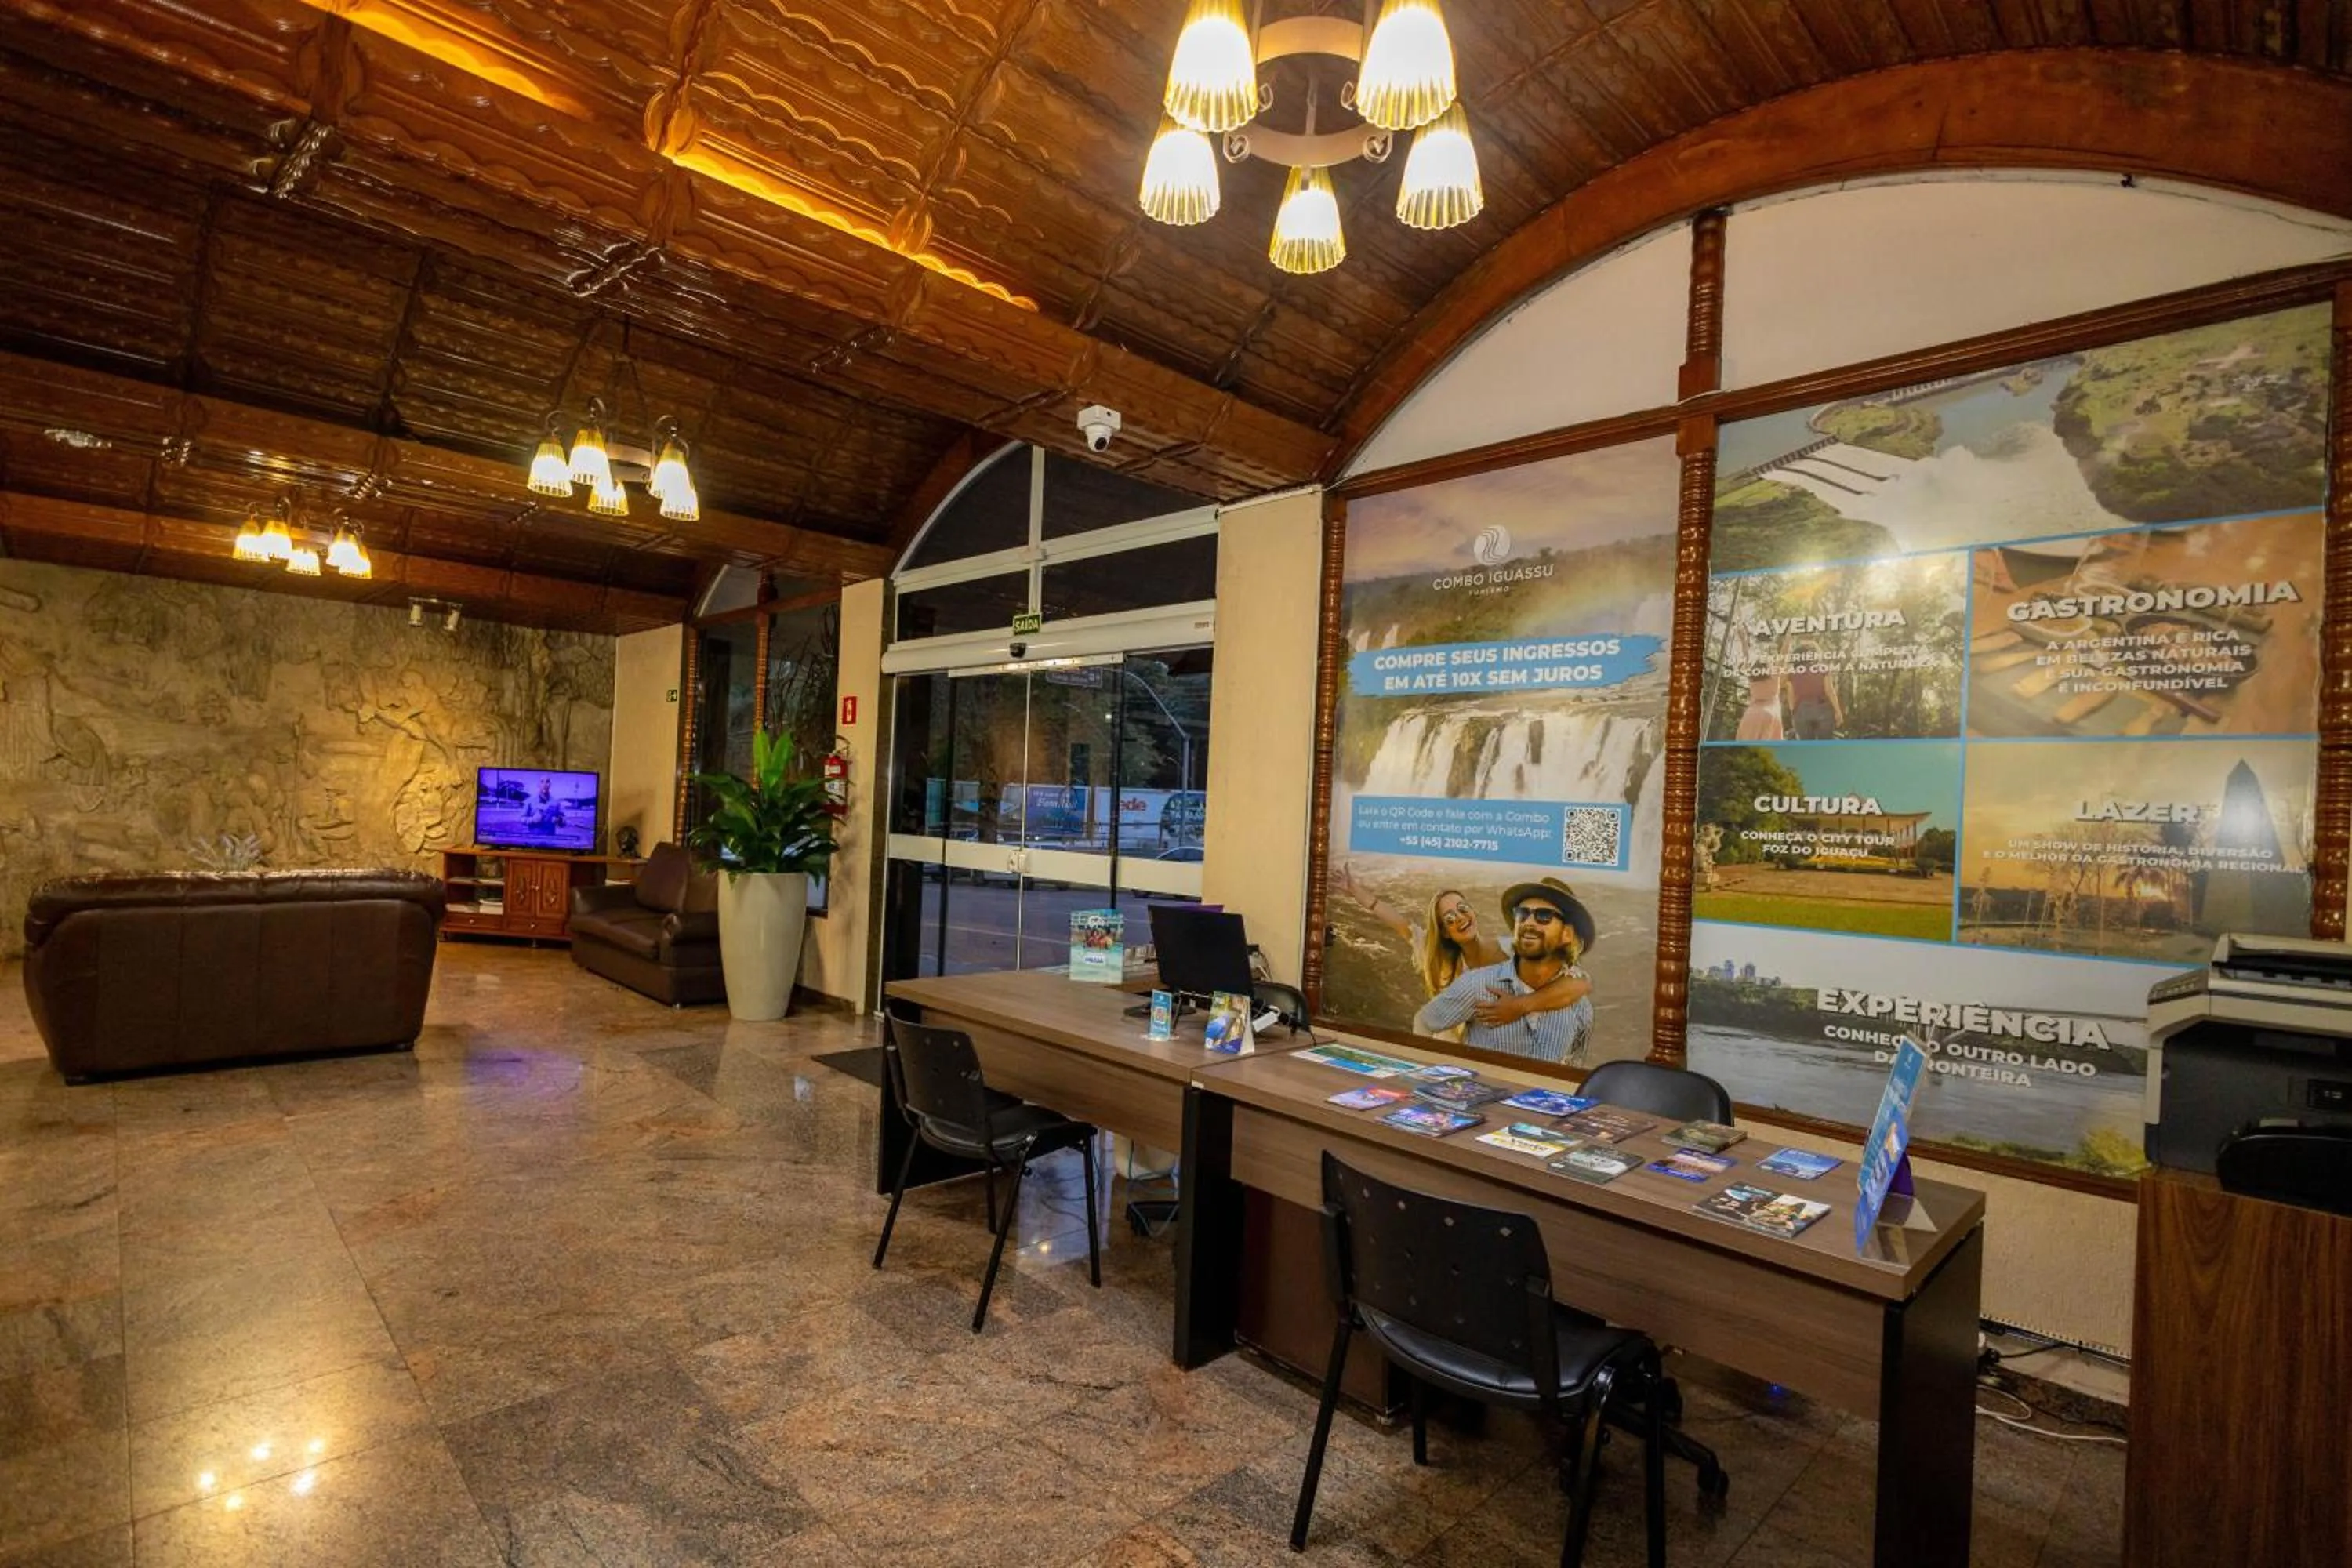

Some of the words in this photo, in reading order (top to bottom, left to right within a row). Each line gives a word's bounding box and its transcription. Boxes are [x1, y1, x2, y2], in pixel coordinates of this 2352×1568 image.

[1432, 573, 1484, 590] COMBO
[1490, 564, 1554, 583] IGUASSU
[2006, 580, 2302, 622] GASTRONOMIA
[1752, 610, 1906, 636] AVENTURA
[2064, 634, 2171, 649] ARGENTINA
[2193, 630, 2241, 643] RICA
[1374, 650, 1446, 671] COMPRE
[1451, 647, 1497, 666] SEUS
[1502, 639, 1621, 662] INGRESSOS
[2036, 655, 2060, 666] EM
[2067, 650, 2147, 664] BELEZAS
[2151, 644, 2252, 660] NATURAIS
[1384, 675, 1408, 691] EM
[1413, 670, 1447, 689] ATÉ
[1452, 671, 1483, 687] 10X
[1487, 668, 1529, 685] SEM
[1533, 664, 1603, 683] JUROS
[1809, 662, 1840, 674] COM
[2060, 667, 2096, 679] SUA
[2102, 662, 2245, 677] GASTRONOMIA
[2073, 676, 2229, 693] INCONFUNDÍVEL
[1389, 806, 1406, 818] QR
[1407, 807, 1434, 818] Code
[1468, 811, 1493, 821] com
[1505, 811, 1550, 823] Combo
[1754, 796, 1882, 815] CULTURA
[2074, 801, 2198, 824] LAZER
[1373, 820, 1399, 829] entre
[1421, 822, 1461, 833] contato
[1464, 826, 1483, 836] por
[1399, 835, 1418, 845] +55
[1421, 836, 1441, 848] (45)
[1443, 836, 1499, 851] 2102-7715
[1740, 830, 1804, 844] CONHEÇA
[1807, 832, 1817, 843] O
[1820, 833, 1851, 845] CITY
[1855, 833, 1896, 847] TOUR
[1762, 844, 1789, 855] FOZ
[1792, 845, 1812, 855] DO
[1815, 845, 1869, 860] IGUAÇU
[1994, 850, 2005, 858] O
[2009, 851, 2068, 862] MELHOR
[2073, 854, 2093, 863] DA
[2009, 840, 2030, 849] UM
[2034, 840, 2078, 851] SHOW
[2082, 843, 2103, 852] DE
[2188, 844, 2273, 858] DIVERSÃO
[1817, 989, 2111, 1051] EXPERIÊNCIA
[1947, 1043, 2024, 1065] OUTRO
[2029, 1058, 2096, 1077] LADO
